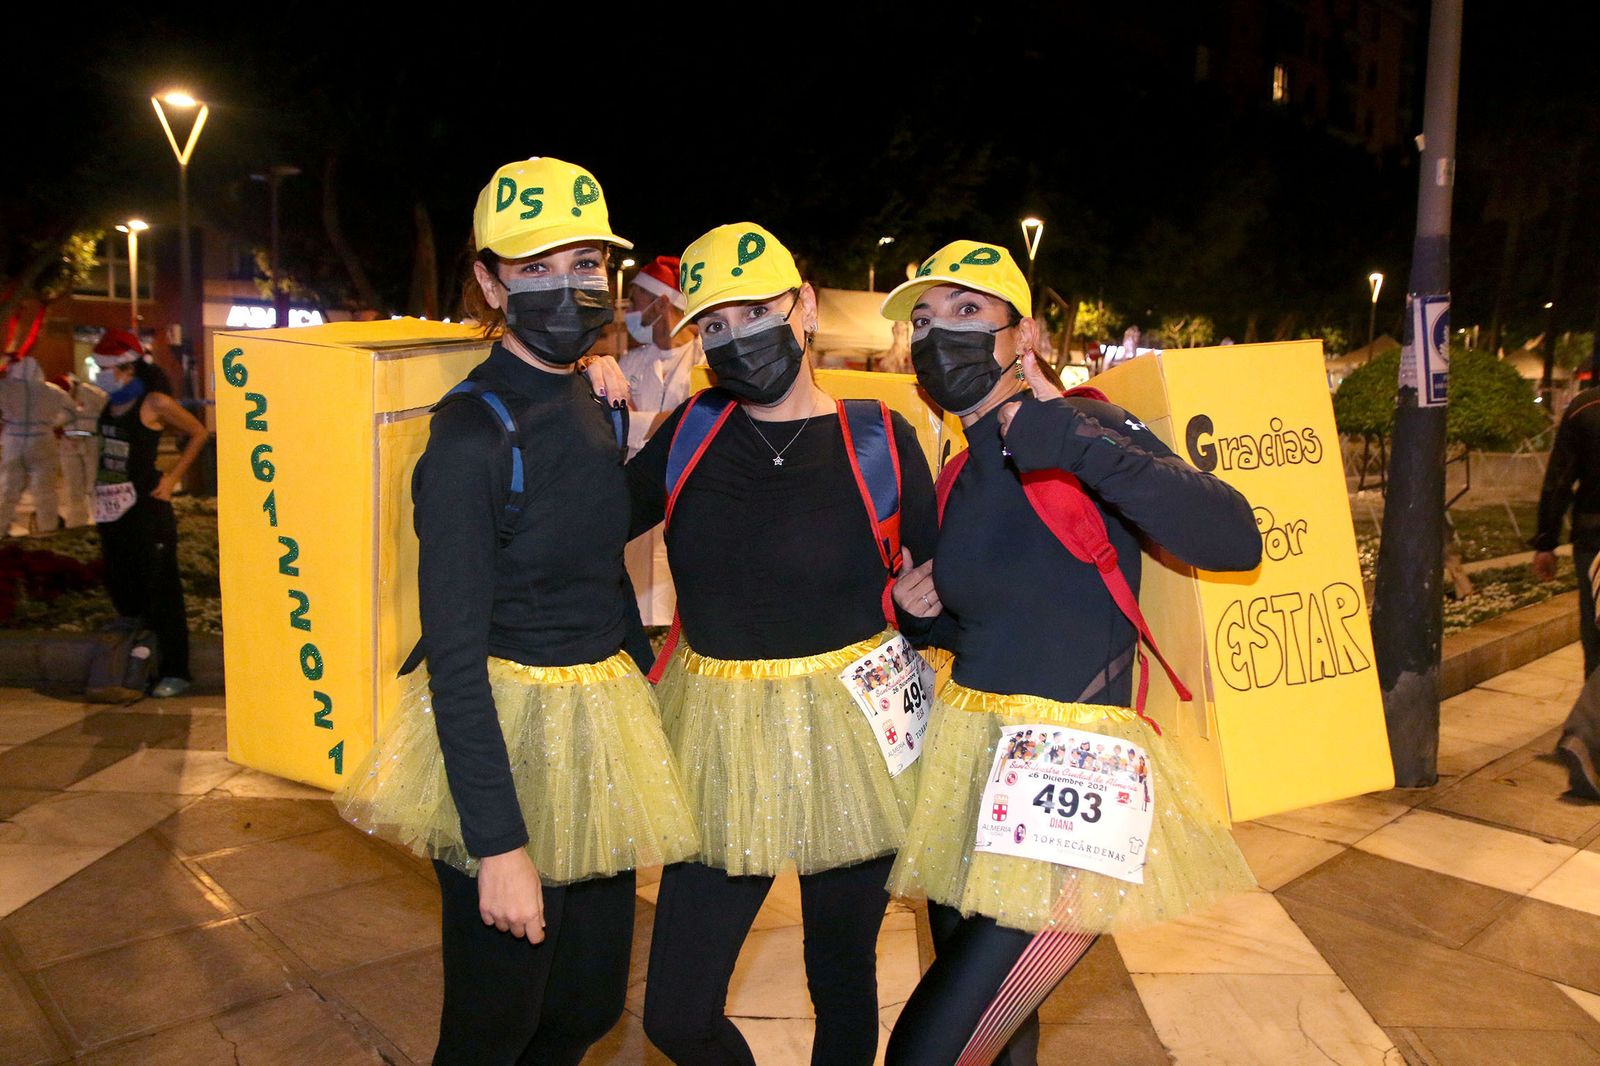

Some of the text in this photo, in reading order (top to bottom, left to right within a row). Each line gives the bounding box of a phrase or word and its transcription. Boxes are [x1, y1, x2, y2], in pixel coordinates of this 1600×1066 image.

[226, 305, 324, 329] ABACA
[1185, 413, 1323, 473] Gracias
[1215, 581, 1371, 692] ESTAR
[1042, 773, 1084, 787] Diciembre
[1087, 781, 1108, 792] 2021
[1032, 783, 1103, 824] 493
[1049, 816, 1074, 832] DIANA
